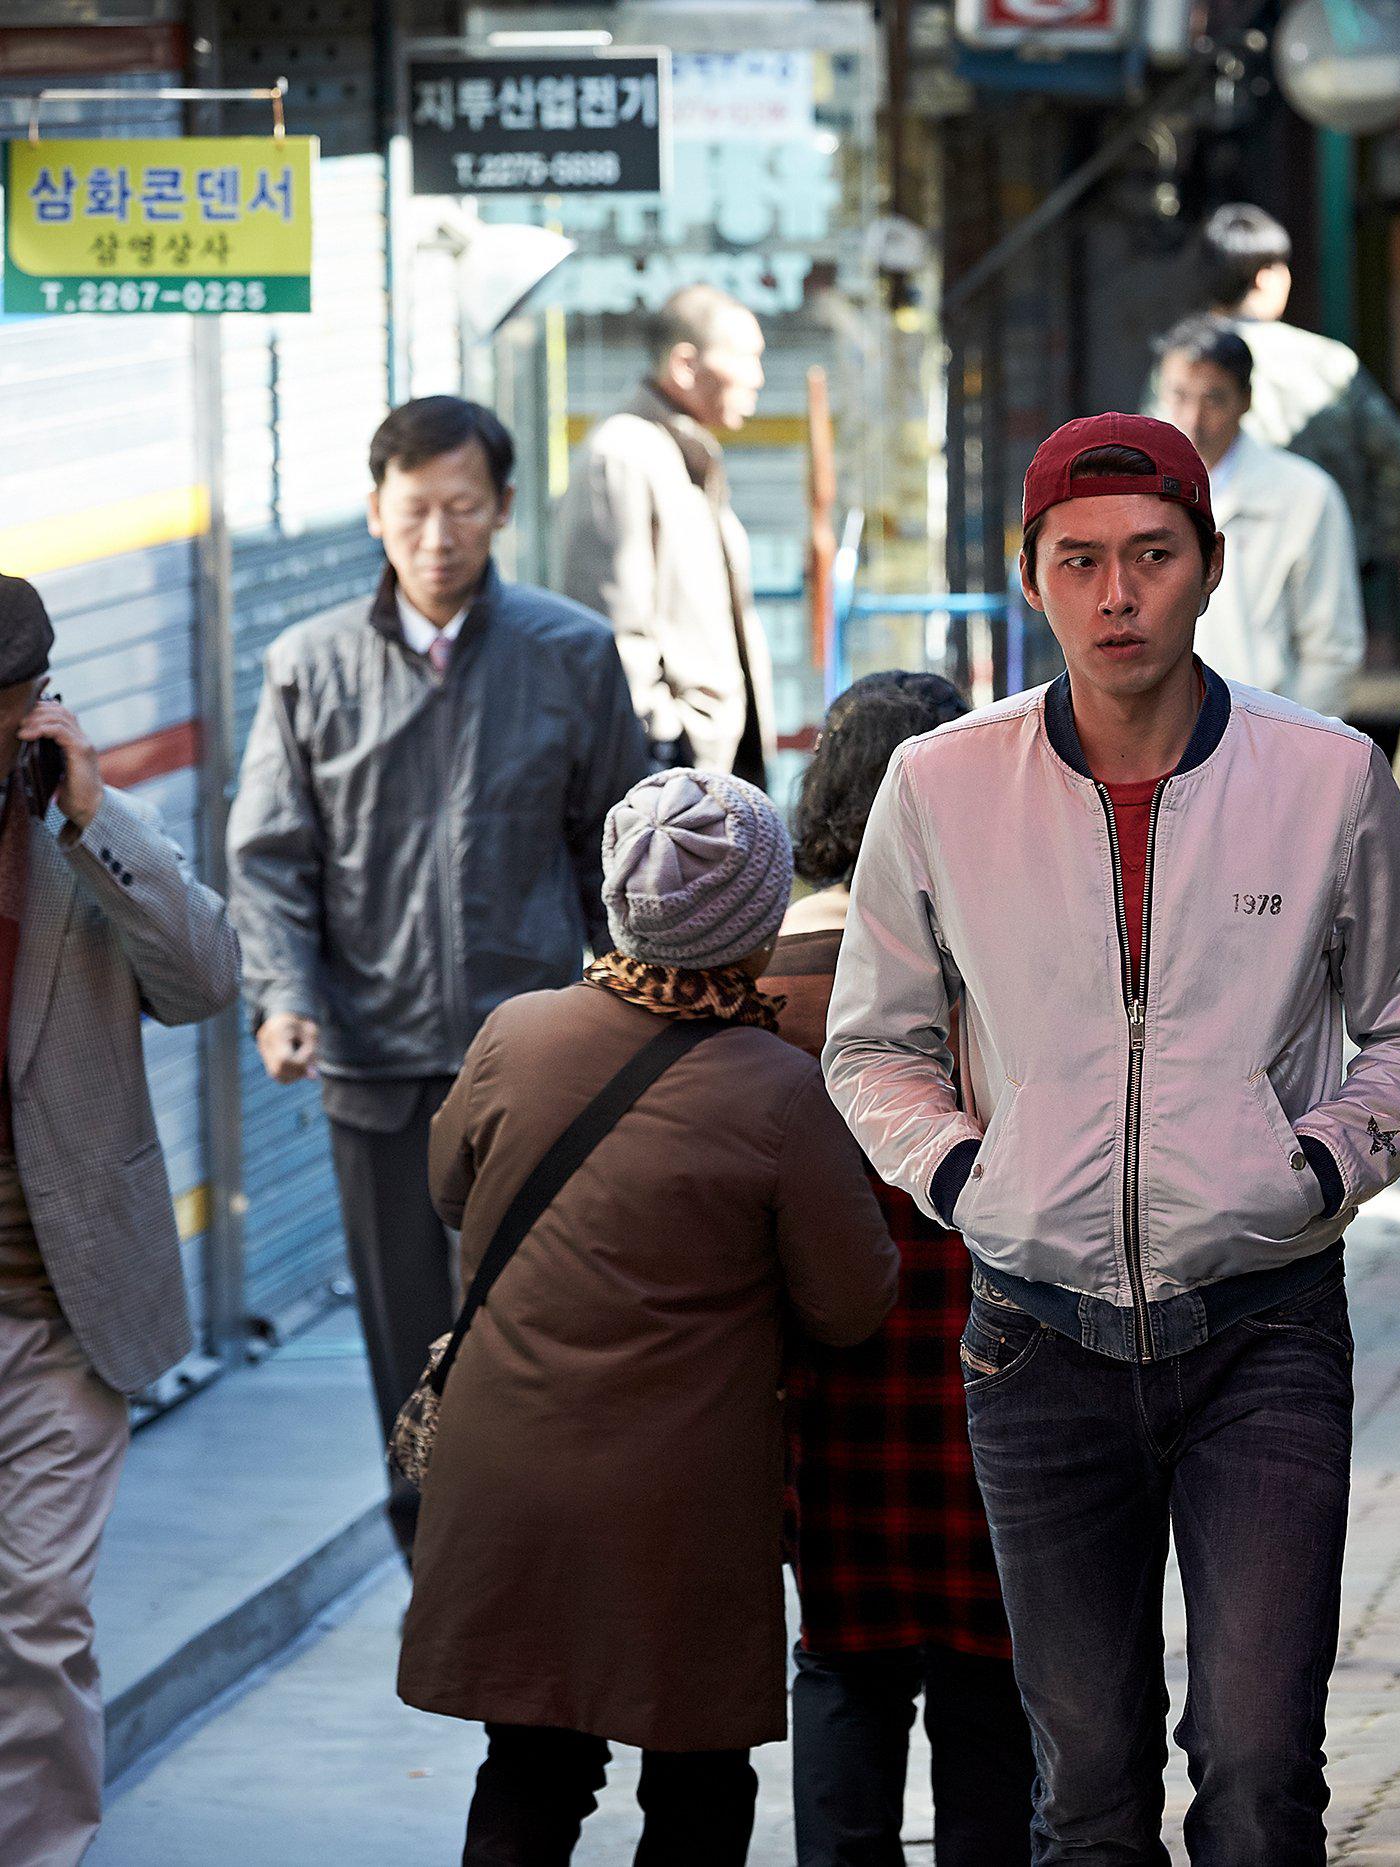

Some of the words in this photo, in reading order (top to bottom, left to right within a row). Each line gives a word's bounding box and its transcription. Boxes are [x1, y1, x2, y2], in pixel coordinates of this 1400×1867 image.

[28, 165, 295, 225] 삼화콘덴서
[88, 231, 232, 268] 삼영상사
[39, 280, 269, 312] T.2267-0225
[1232, 893, 1283, 916] 1978
